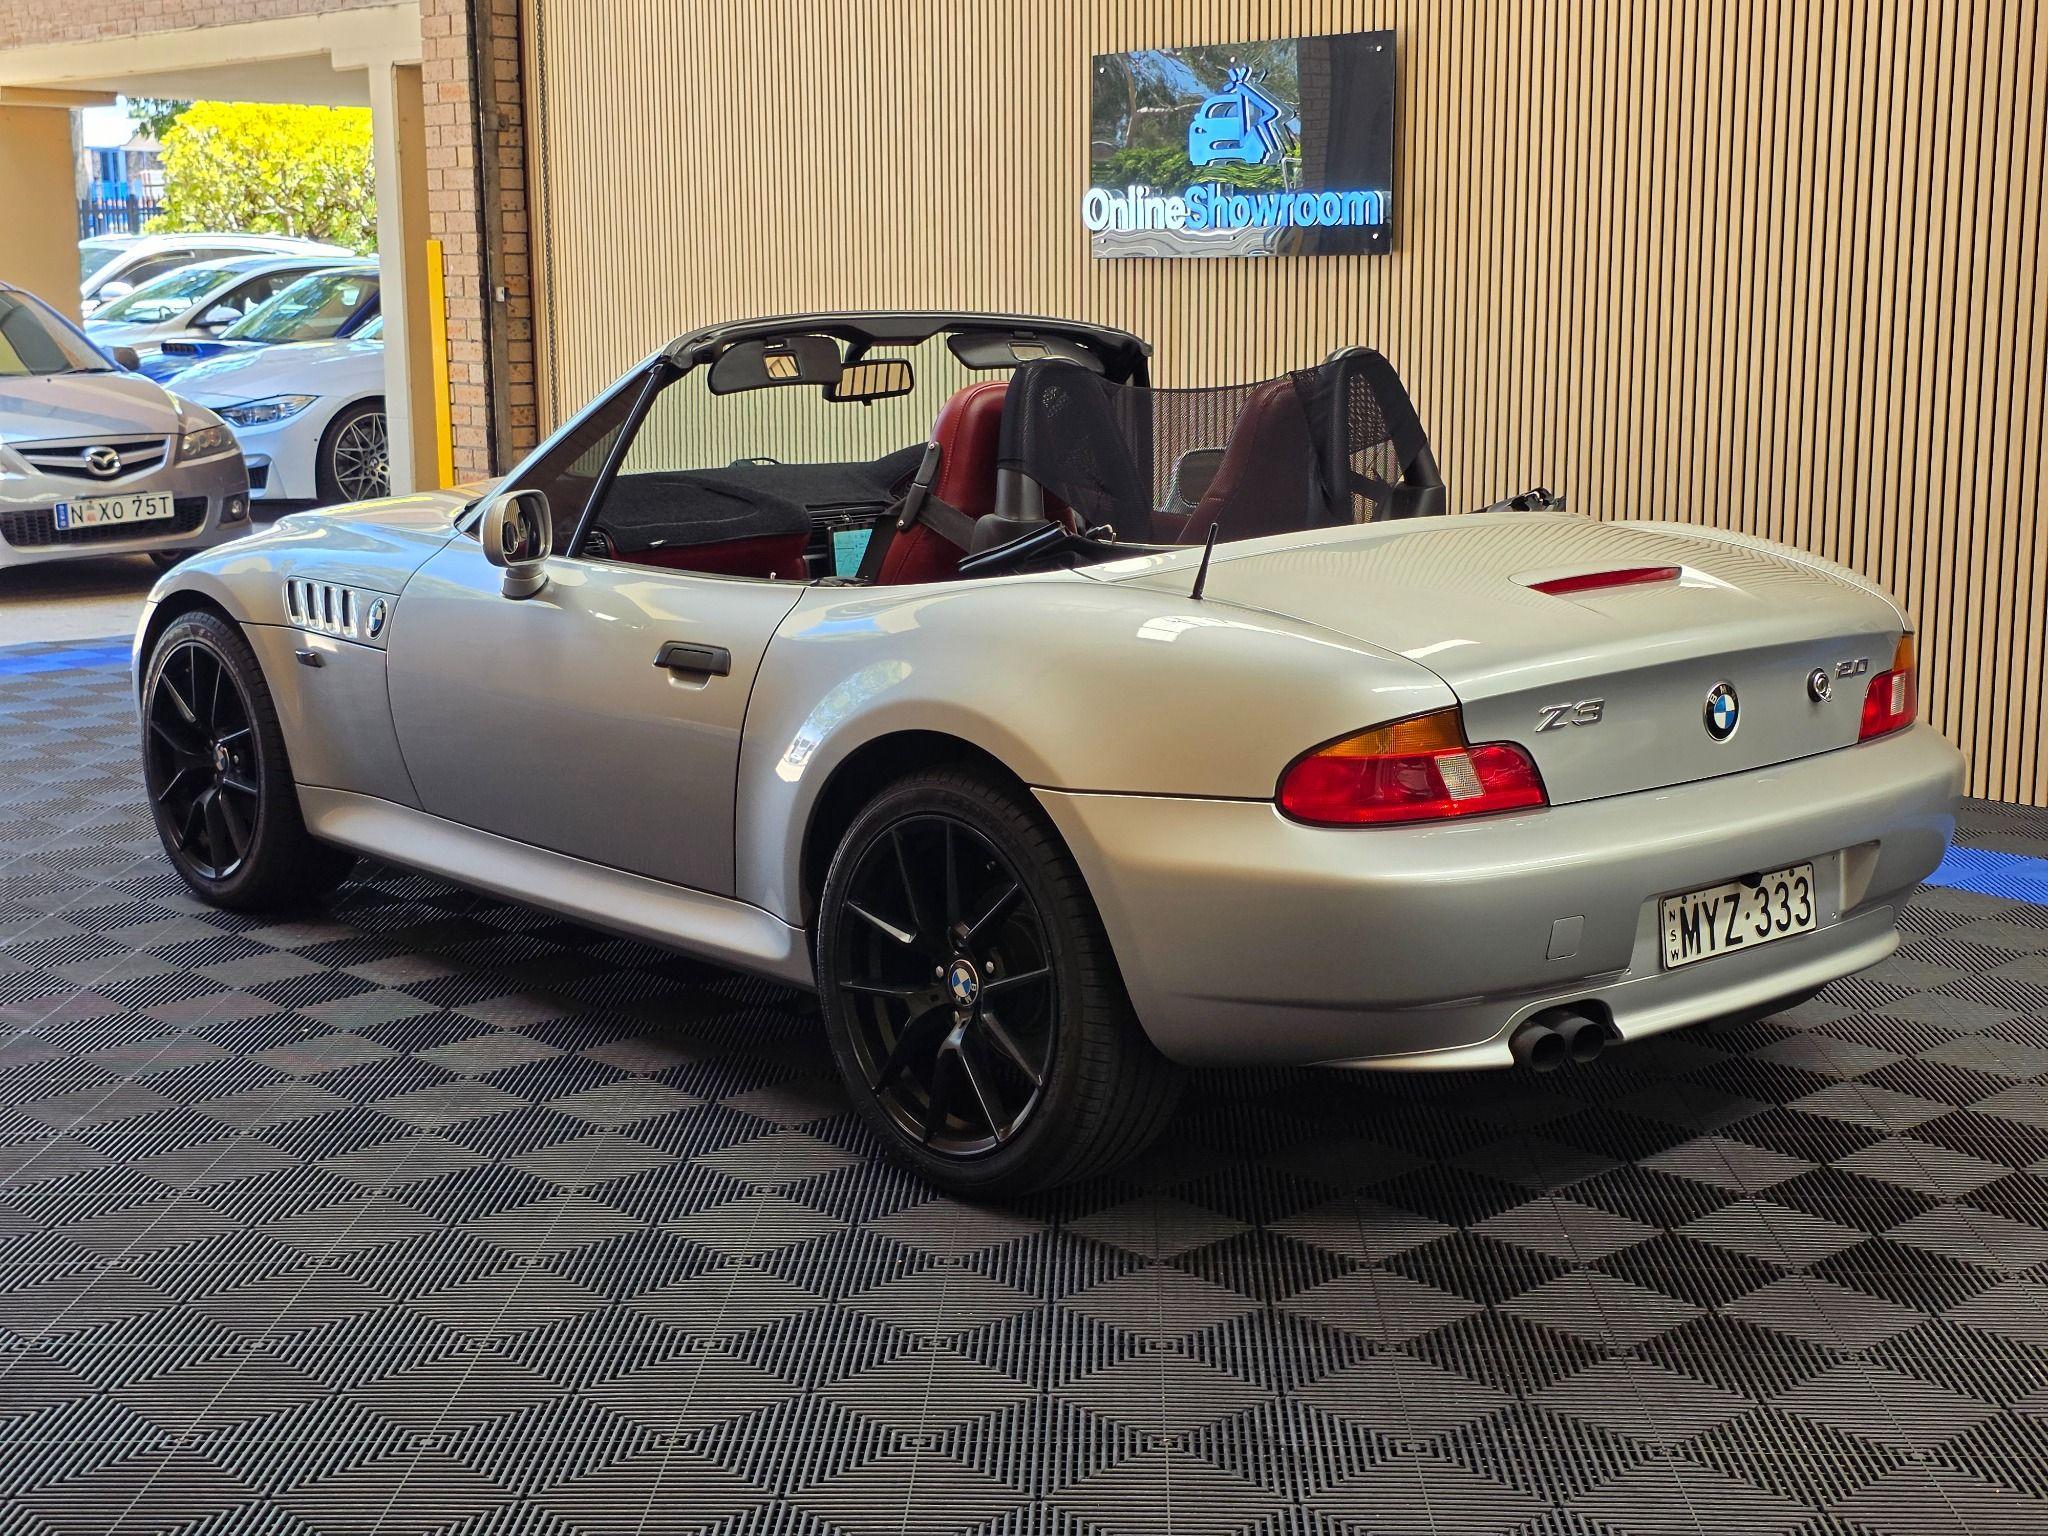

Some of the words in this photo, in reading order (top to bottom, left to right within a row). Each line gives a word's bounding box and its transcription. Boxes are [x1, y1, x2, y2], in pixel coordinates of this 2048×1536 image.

[1082, 183, 1382, 231] OnlineShowroom
[70, 504, 84, 524] N
[132, 496, 170, 517] 75T
[1535, 697, 1605, 733] Z3
